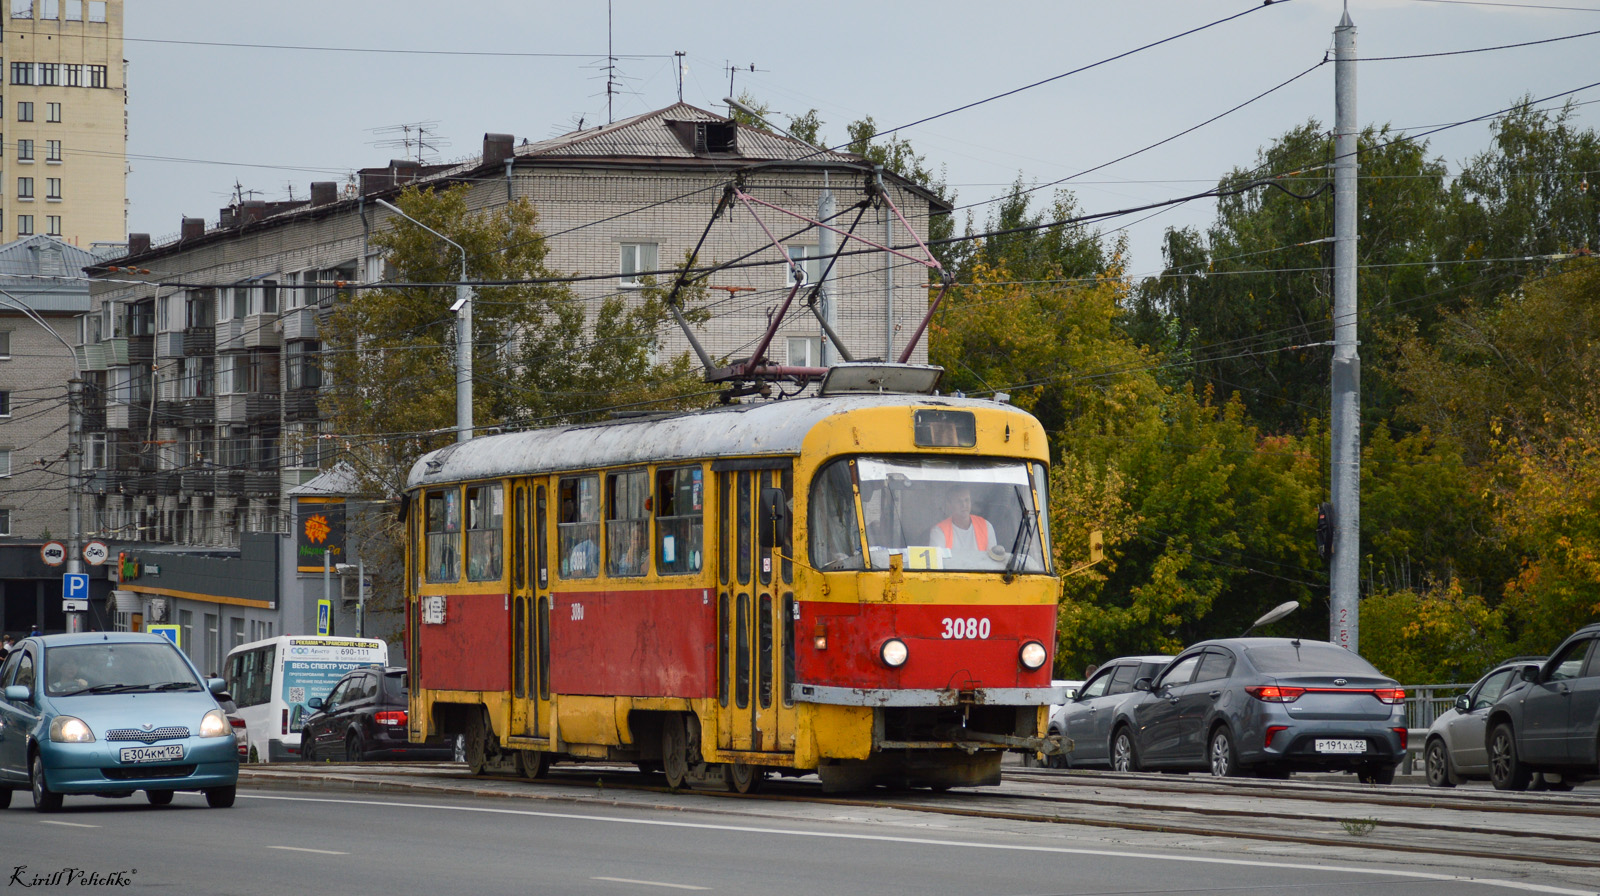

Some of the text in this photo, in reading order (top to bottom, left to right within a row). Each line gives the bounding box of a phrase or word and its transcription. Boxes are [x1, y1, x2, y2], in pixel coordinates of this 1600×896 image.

[919, 549, 931, 569] 1
[70, 576, 84, 596] P
[941, 617, 991, 639] 3080
[165, 746, 181, 755] 122
[1355, 740, 1364, 748] 22
